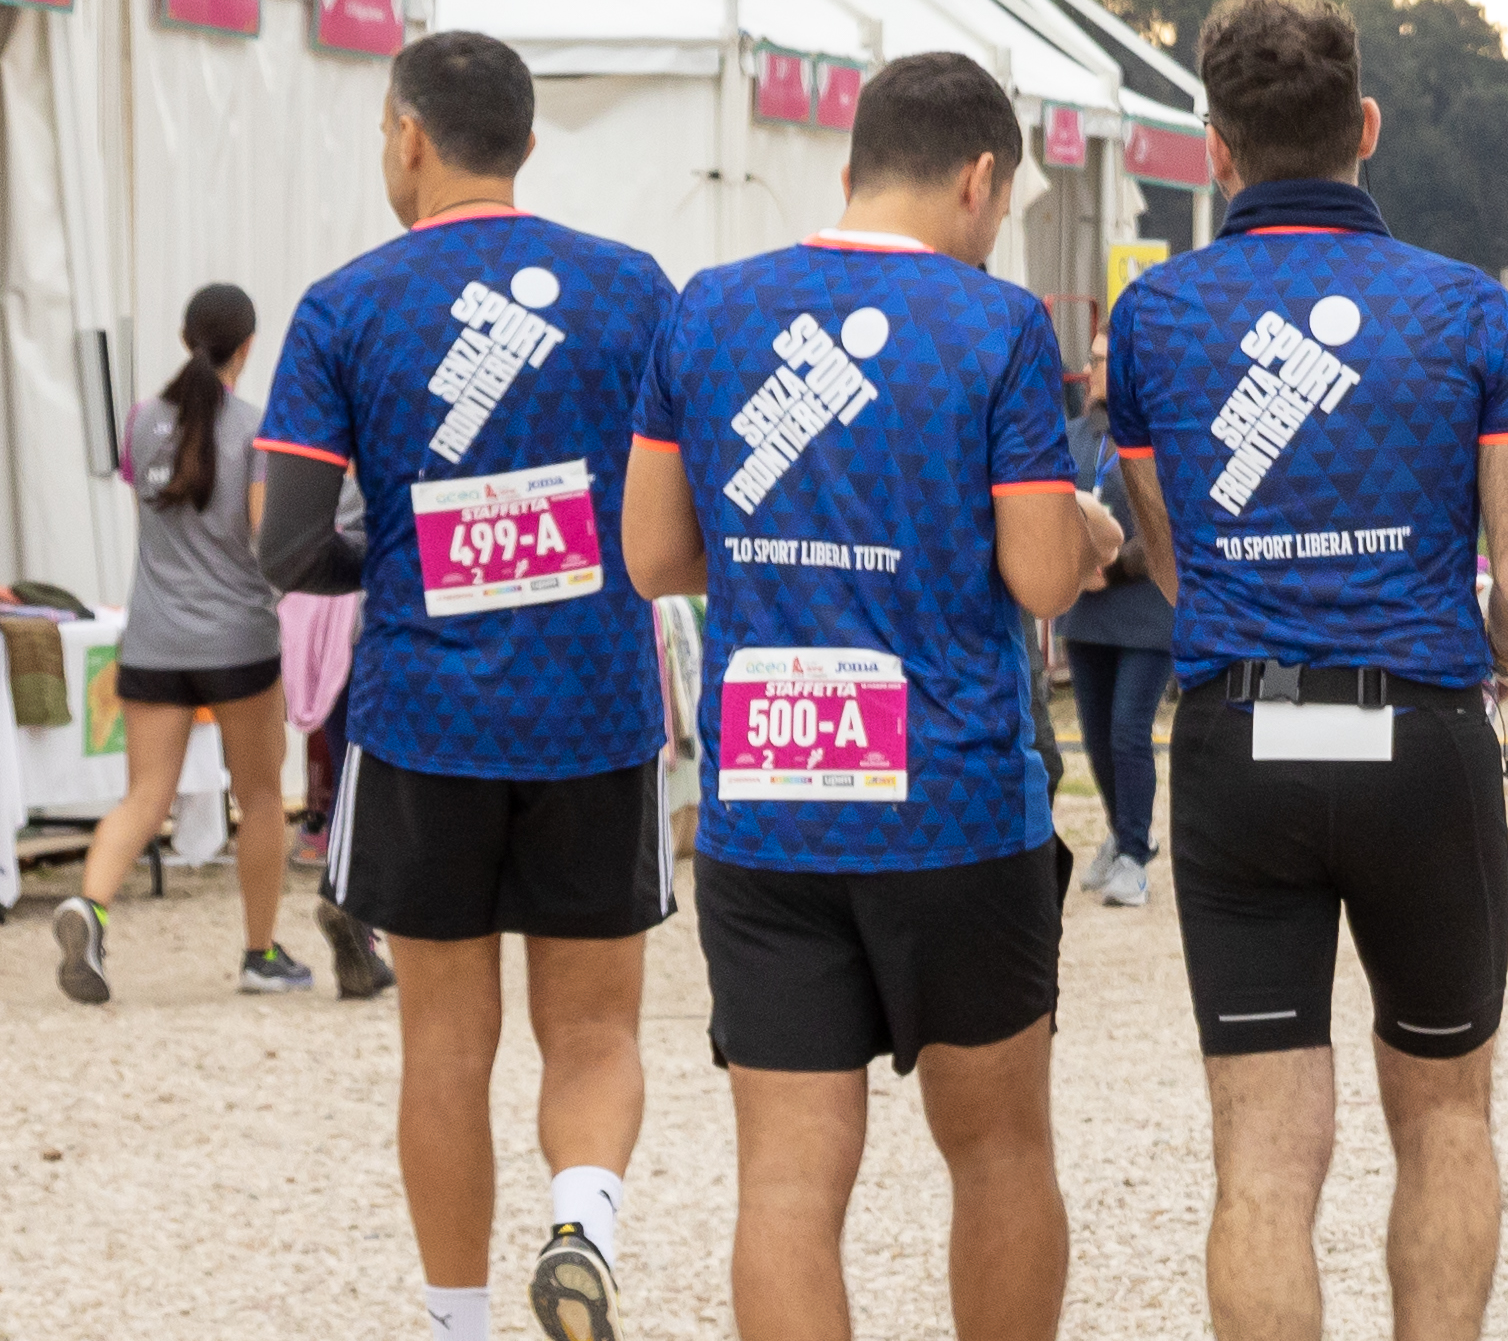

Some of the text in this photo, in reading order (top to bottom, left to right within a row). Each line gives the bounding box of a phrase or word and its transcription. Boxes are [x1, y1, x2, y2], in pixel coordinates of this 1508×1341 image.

[450, 281, 566, 369] SPORT
[428, 326, 496, 404] SENZA
[772, 312, 878, 426] SPORT
[1240, 311, 1361, 414] SPORT
[730, 364, 808, 448] SENZA
[1211, 364, 1285, 451] SENZA
[722, 388, 834, 516] FRONTIERE
[1209, 384, 1315, 517] FRONTIERE
[450, 512, 567, 567] 499-A
[461, 497, 549, 523] STAFFETTA
[471, 567, 485, 585] 2
[753, 538, 798, 565] SPORT
[801, 540, 851, 569] LIBERA
[1244, 534, 1295, 560] SPORT
[1296, 531, 1353, 559] LIBERA
[765, 681, 857, 698] STAFFETTA
[747, 698, 869, 748] 500-A
[762, 749, 775, 770] 2
